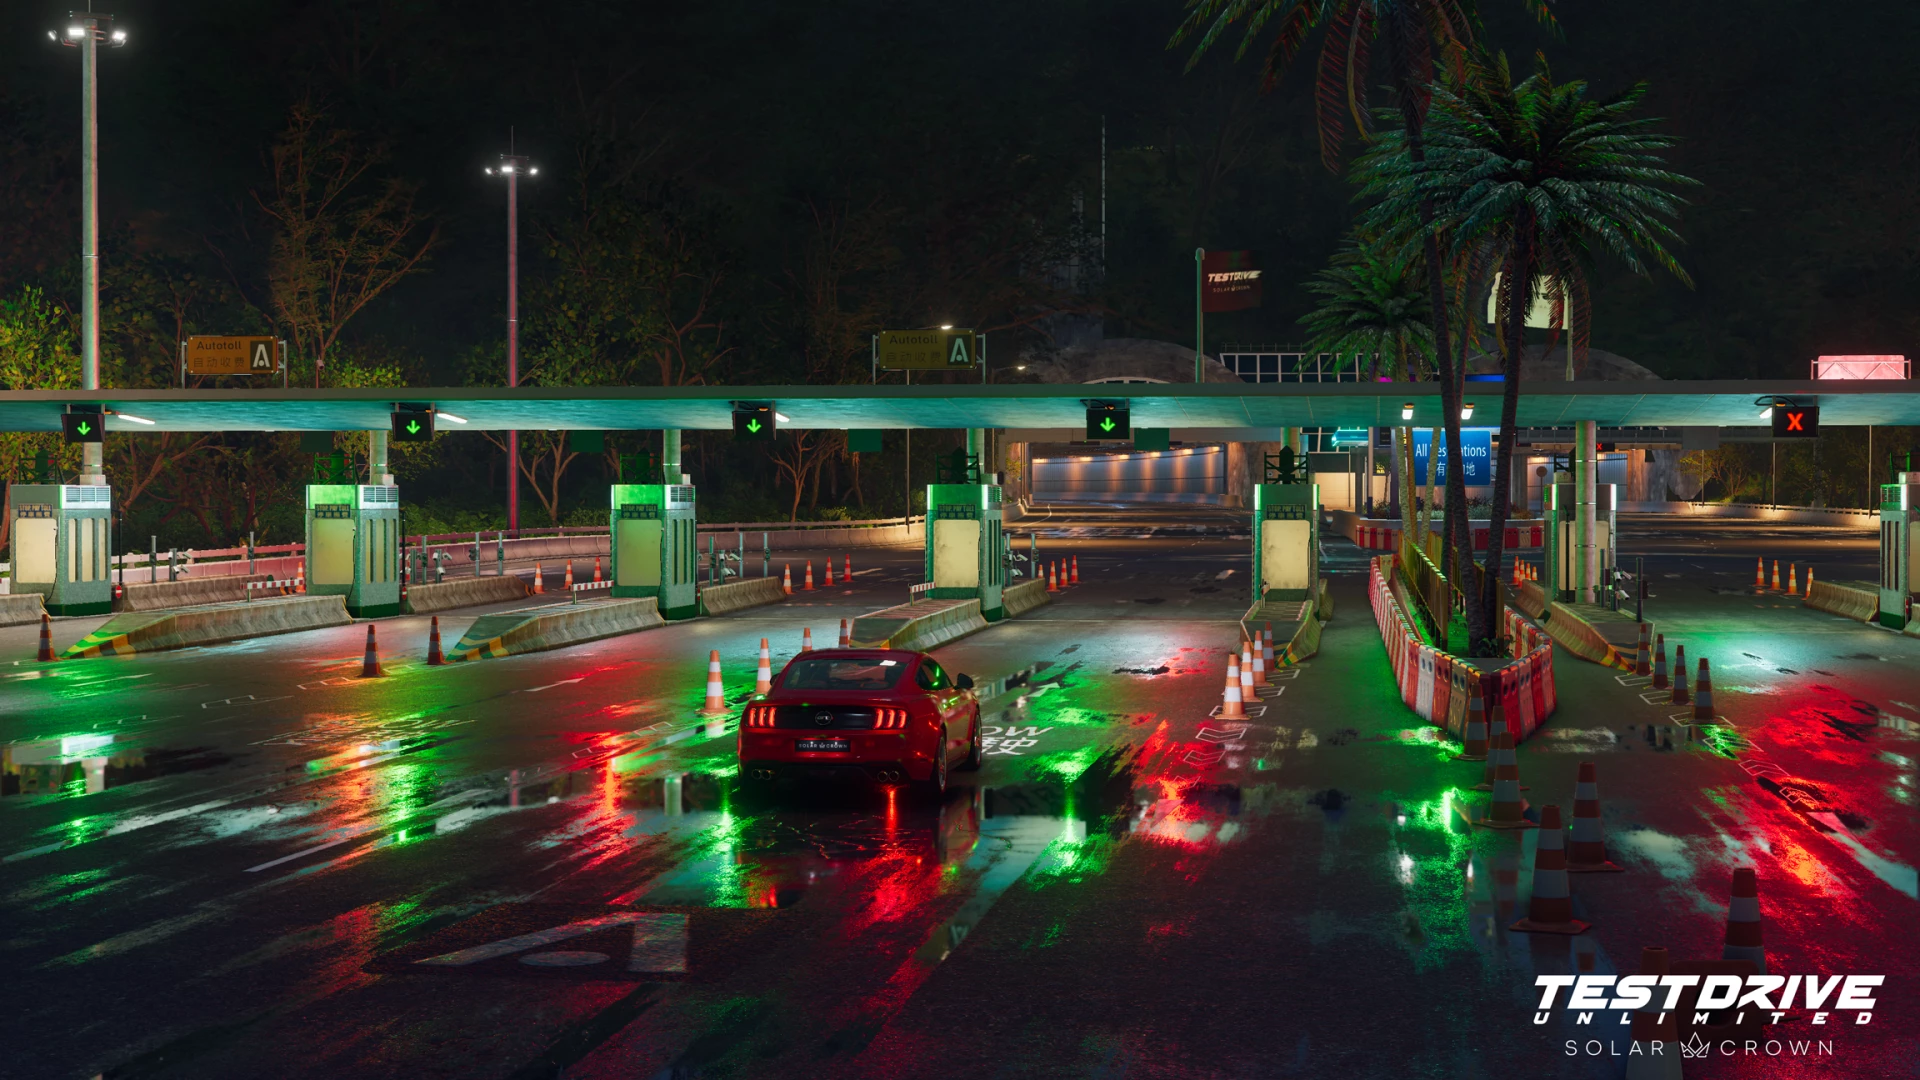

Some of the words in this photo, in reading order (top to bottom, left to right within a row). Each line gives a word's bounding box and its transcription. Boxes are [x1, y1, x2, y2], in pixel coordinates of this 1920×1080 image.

[889, 335, 938, 344] Autotoll
[196, 341, 242, 350] Autotoll
[1415, 443, 1428, 457] All
